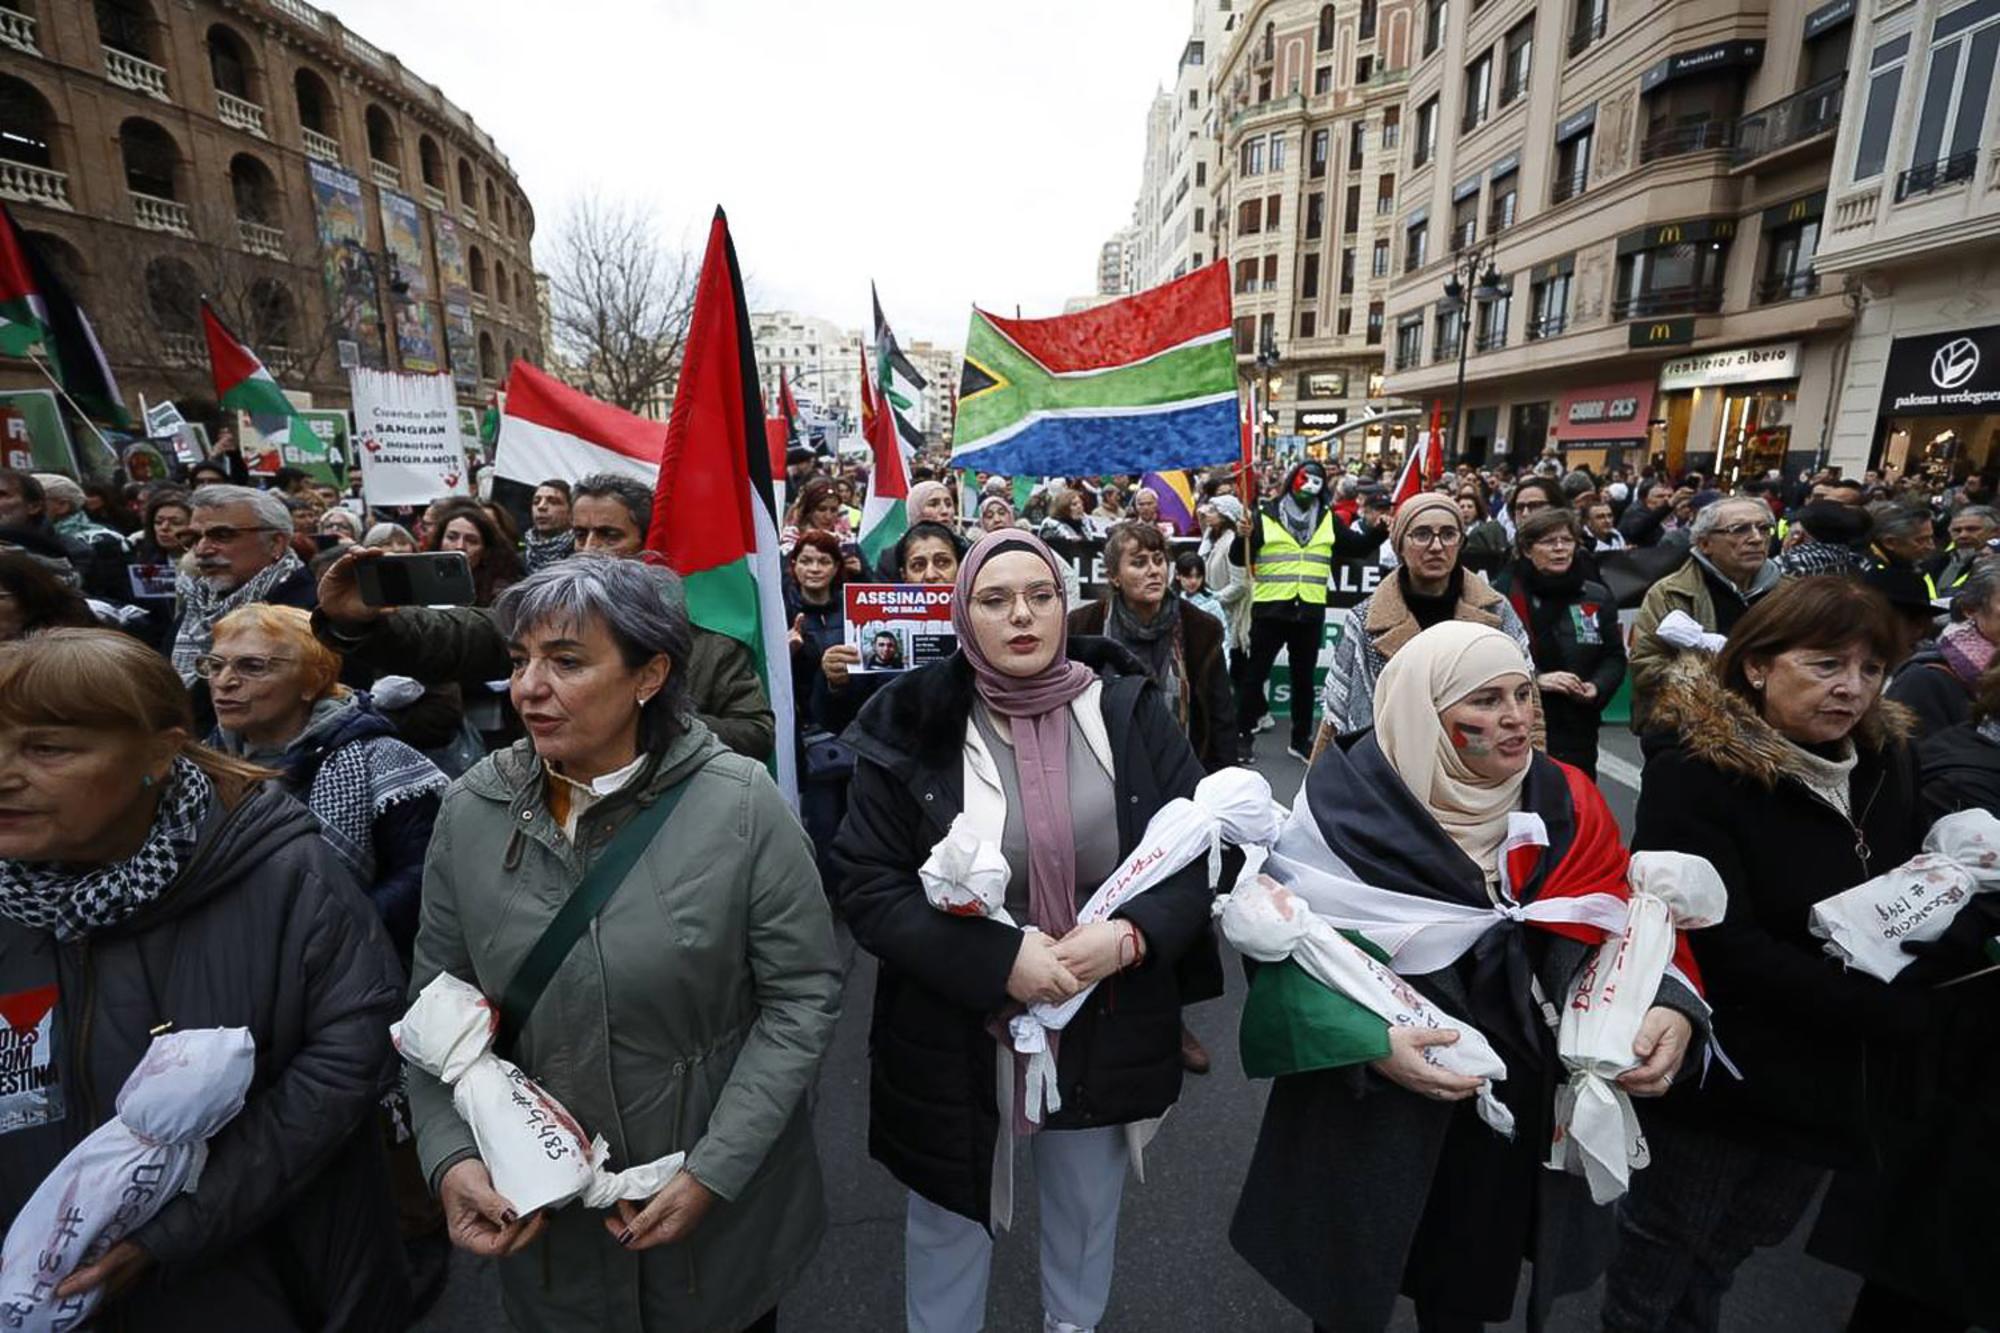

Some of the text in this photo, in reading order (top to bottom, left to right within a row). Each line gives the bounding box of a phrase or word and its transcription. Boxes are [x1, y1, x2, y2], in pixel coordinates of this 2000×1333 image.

[1894, 393, 1938, 410] paloma
[375, 423, 446, 435] SANGRAN
[386, 441, 444, 450] nosotros
[374, 454, 458, 464] SANGRAMOS
[856, 591, 954, 605] ASESINADO
